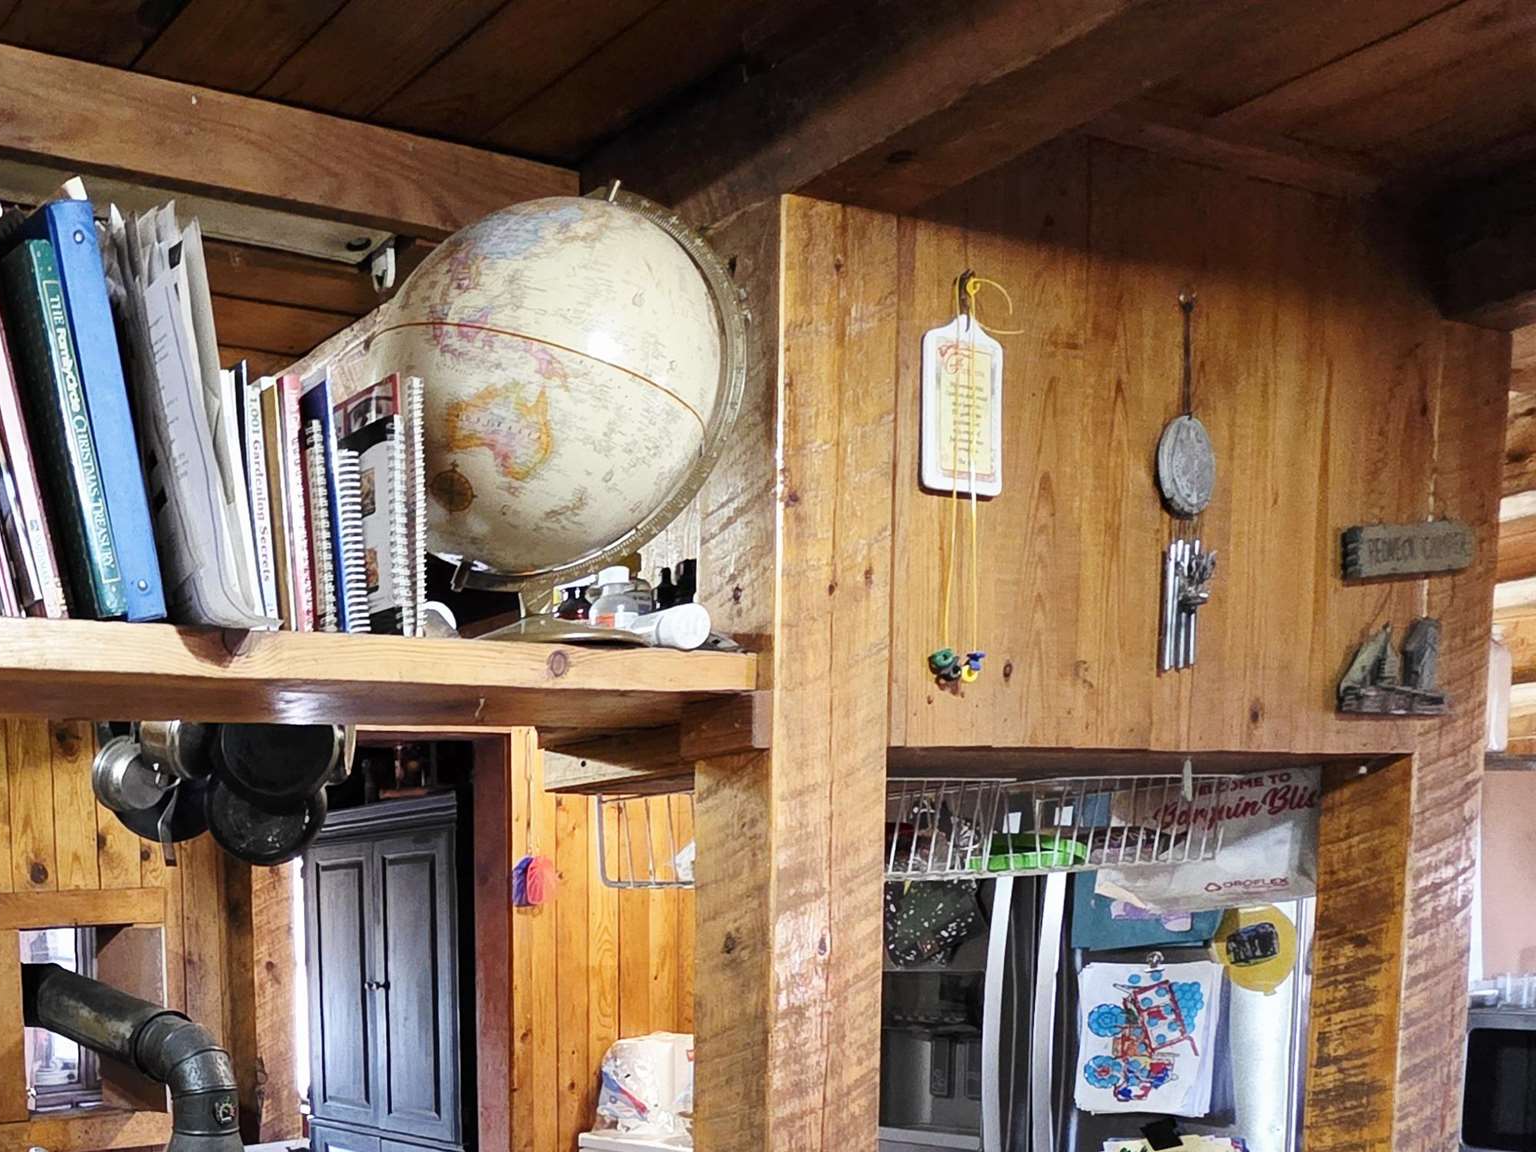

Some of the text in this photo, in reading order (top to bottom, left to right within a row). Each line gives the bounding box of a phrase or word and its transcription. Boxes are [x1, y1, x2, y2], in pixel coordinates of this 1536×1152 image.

[50, 294, 65, 327] THE
[73, 414, 103, 498] CHRISTMAS
[90, 498, 116, 571] TREASURY
[248, 397, 272, 583] 1,001 Gardening Secrets
[1268, 772, 1293, 784] TO
